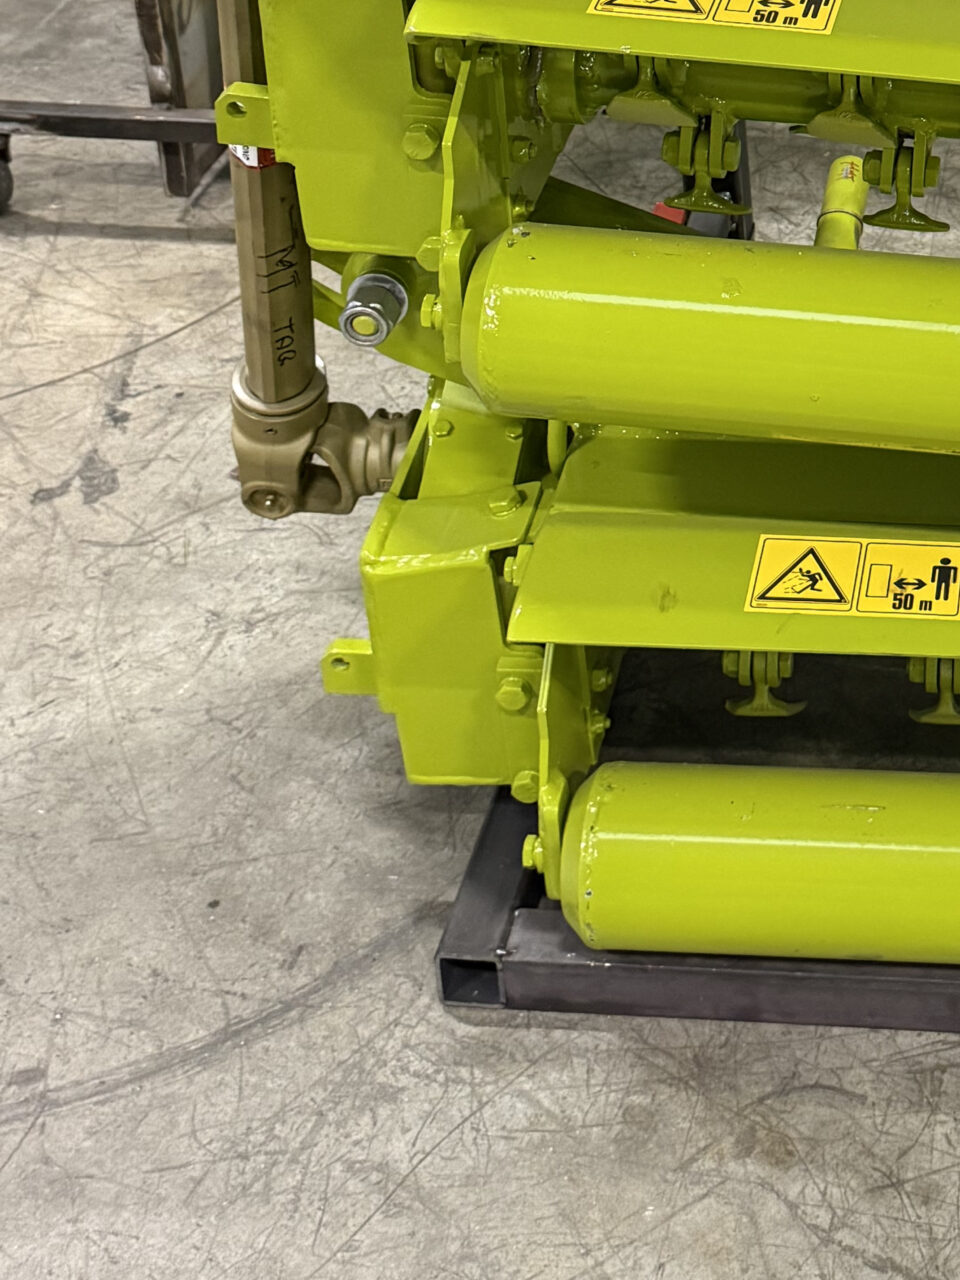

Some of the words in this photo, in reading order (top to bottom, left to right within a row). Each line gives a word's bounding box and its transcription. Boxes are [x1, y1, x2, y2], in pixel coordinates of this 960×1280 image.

[752, 10, 779, 24] 50
[783, 16, 799, 26] m
[892, 593, 914, 611] 50
[919, 599, 933, 612] m
